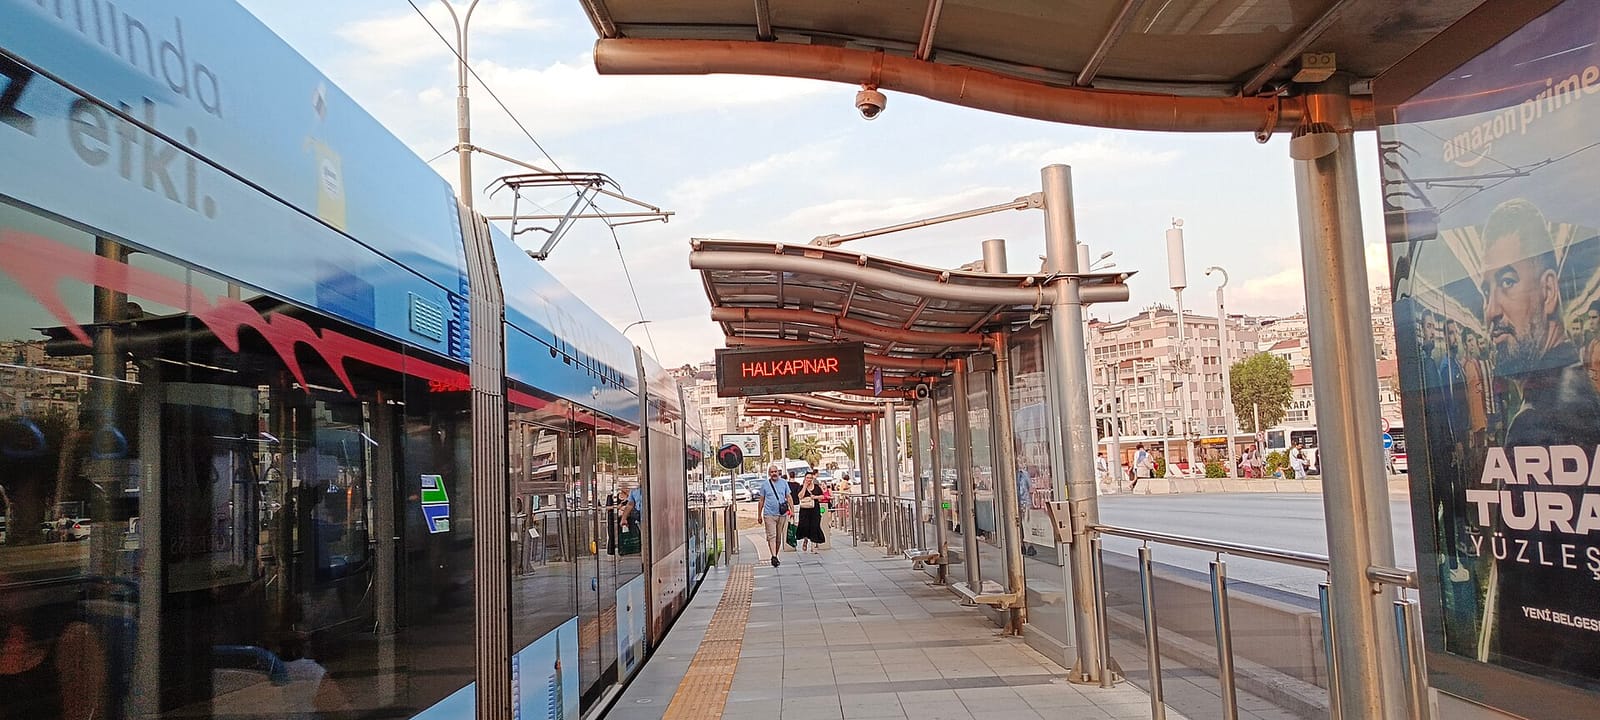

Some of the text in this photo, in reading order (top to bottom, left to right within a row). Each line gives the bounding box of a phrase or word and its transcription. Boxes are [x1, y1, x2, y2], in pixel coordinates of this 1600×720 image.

[1443, 65, 1600, 163] amazon prime
[68, 96, 218, 220] etki.
[742, 357, 839, 378] HALKAPINAR
[1471, 532, 1600, 581] YÜZLEŞ
[1522, 606, 1600, 632] YENİ BELGES
